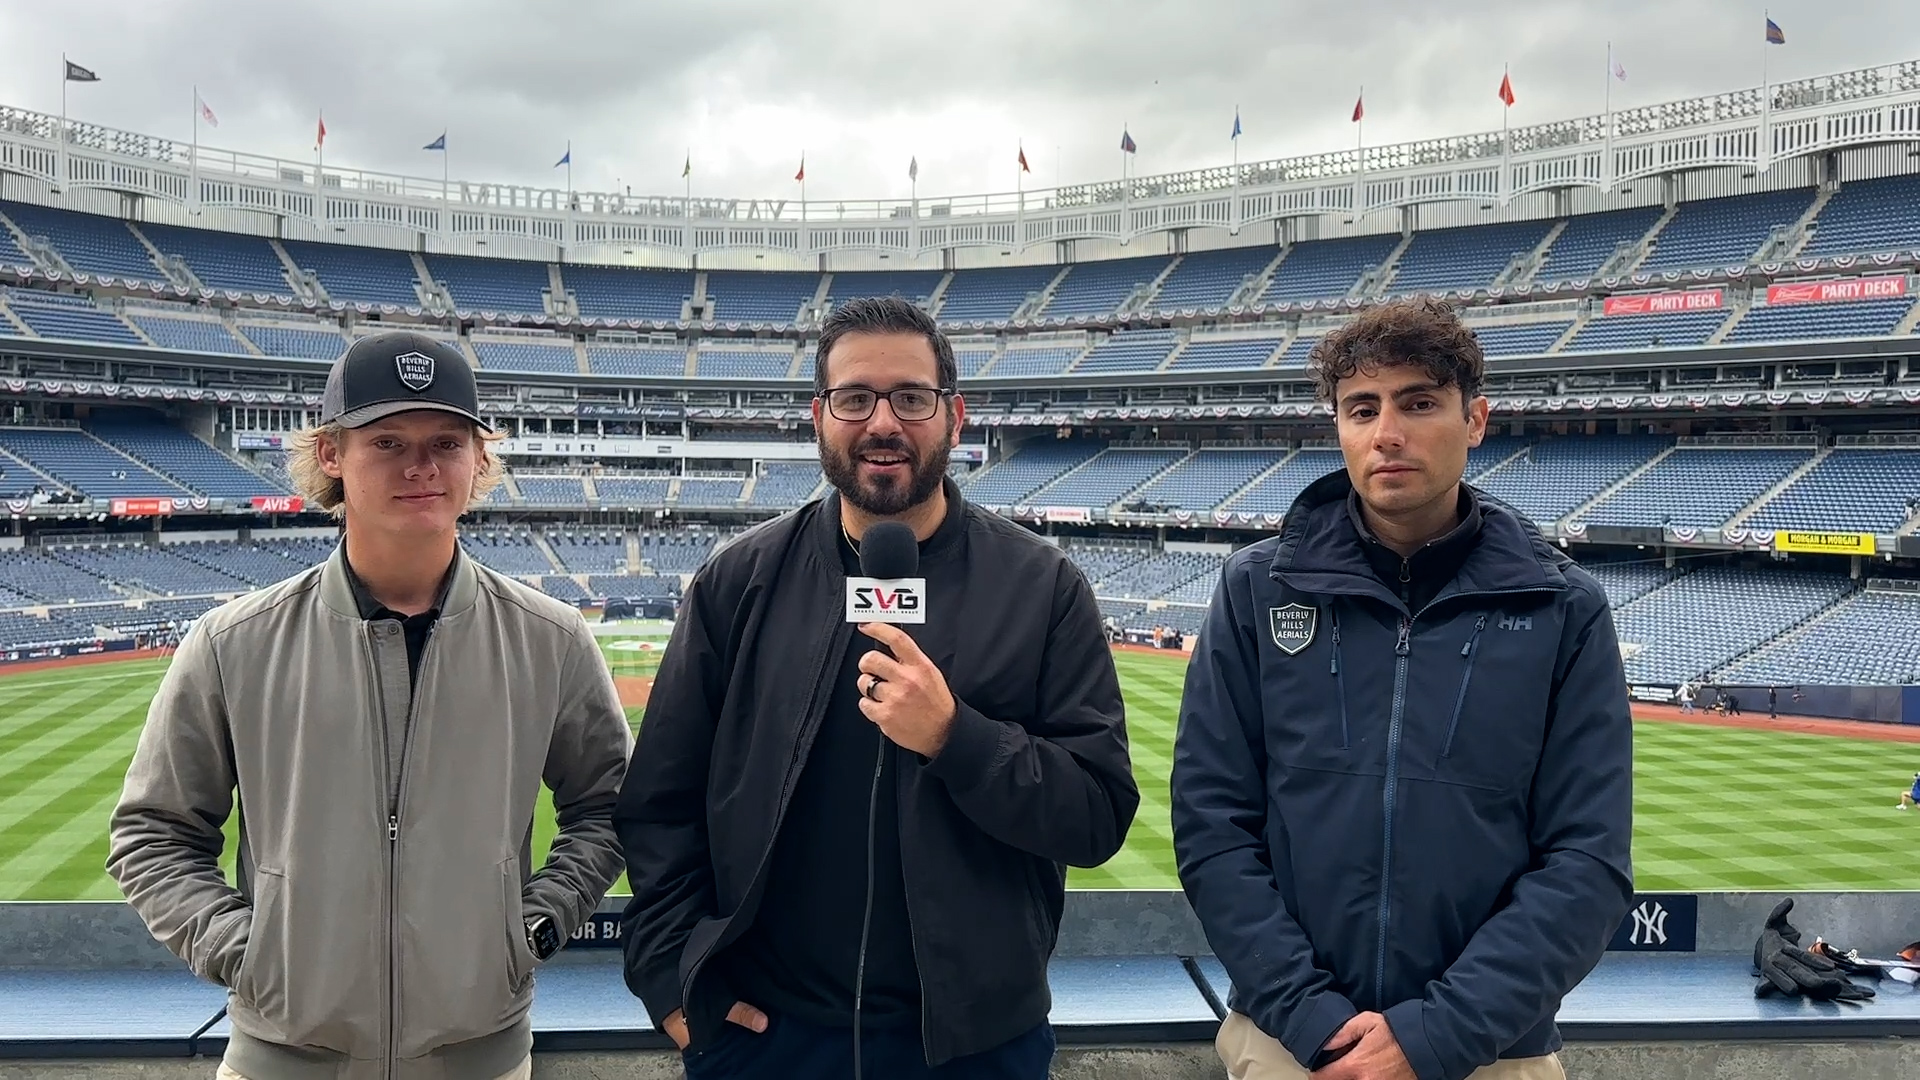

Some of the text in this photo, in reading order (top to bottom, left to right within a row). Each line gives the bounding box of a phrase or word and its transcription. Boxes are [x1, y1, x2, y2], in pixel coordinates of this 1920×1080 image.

[1822, 282, 1862, 299] PARTY
[1864, 280, 1900, 296] DECK
[1650, 295, 1685, 311] PARTY
[1686, 293, 1717, 308] DECK
[401, 357, 430, 366] BEVERLY
[406, 365, 426, 373] HILLS
[403, 373, 431, 381] AERIALS
[261, 498, 291, 511] AVIS
[1790, 534, 1858, 545] MORGAN & MORGAN
[854, 588, 918, 609] SVG
[1276, 611, 1309, 619] BEVERLY
[1281, 620, 1304, 629] HILLS
[1276, 630, 1309, 639] AERIALS
